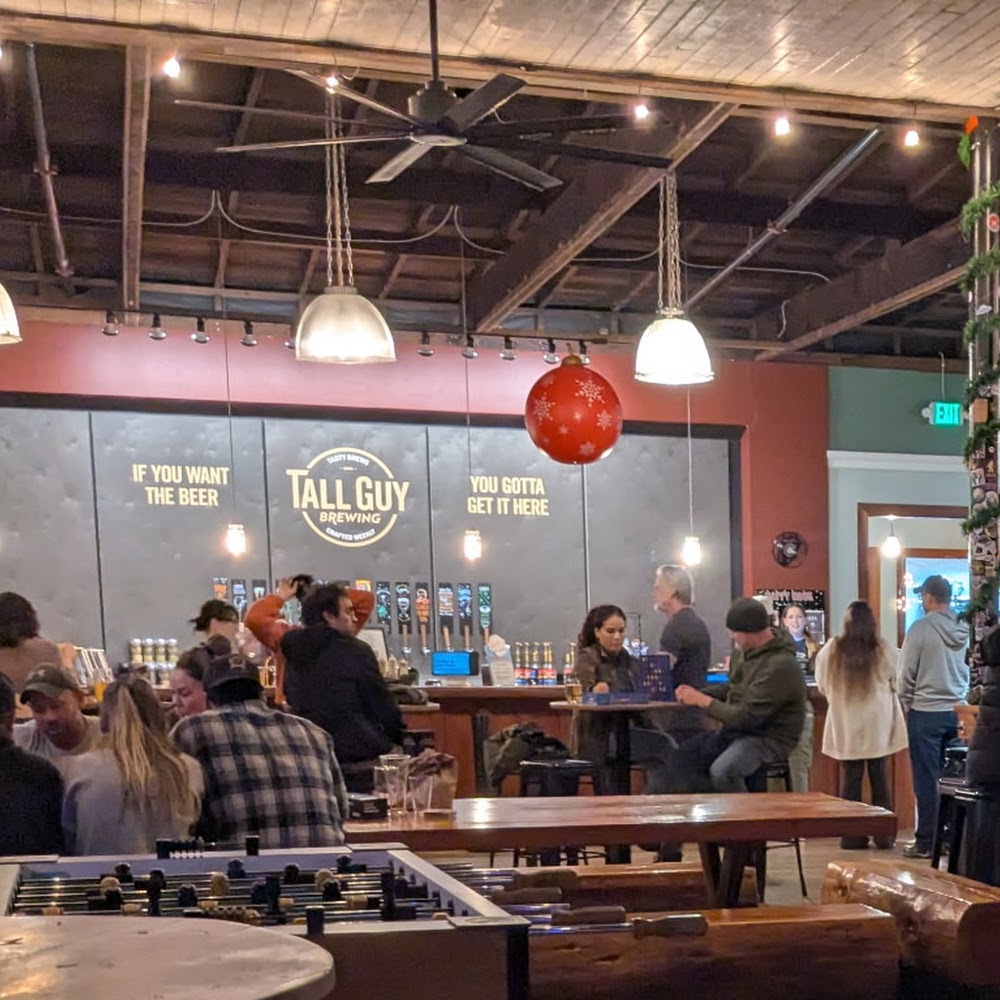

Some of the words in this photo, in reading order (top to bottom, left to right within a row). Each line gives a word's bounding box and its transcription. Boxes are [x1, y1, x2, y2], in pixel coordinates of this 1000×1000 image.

[935, 403, 960, 424] EXIT
[132, 464, 148, 482] IF
[150, 464, 182, 484] YOU
[185, 465, 230, 485] WANT
[285, 469, 352, 510] TALL
[355, 475, 410, 512] GUY
[470, 476, 498, 494] YOU
[502, 476, 545, 495] GOTTA
[144, 487, 176, 505] THE
[179, 487, 219, 506] BEER
[467, 496, 494, 515] GET
[496, 497, 510, 515] IT
[513, 498, 550, 516] HERE
[319, 511, 382, 525] BREWING
